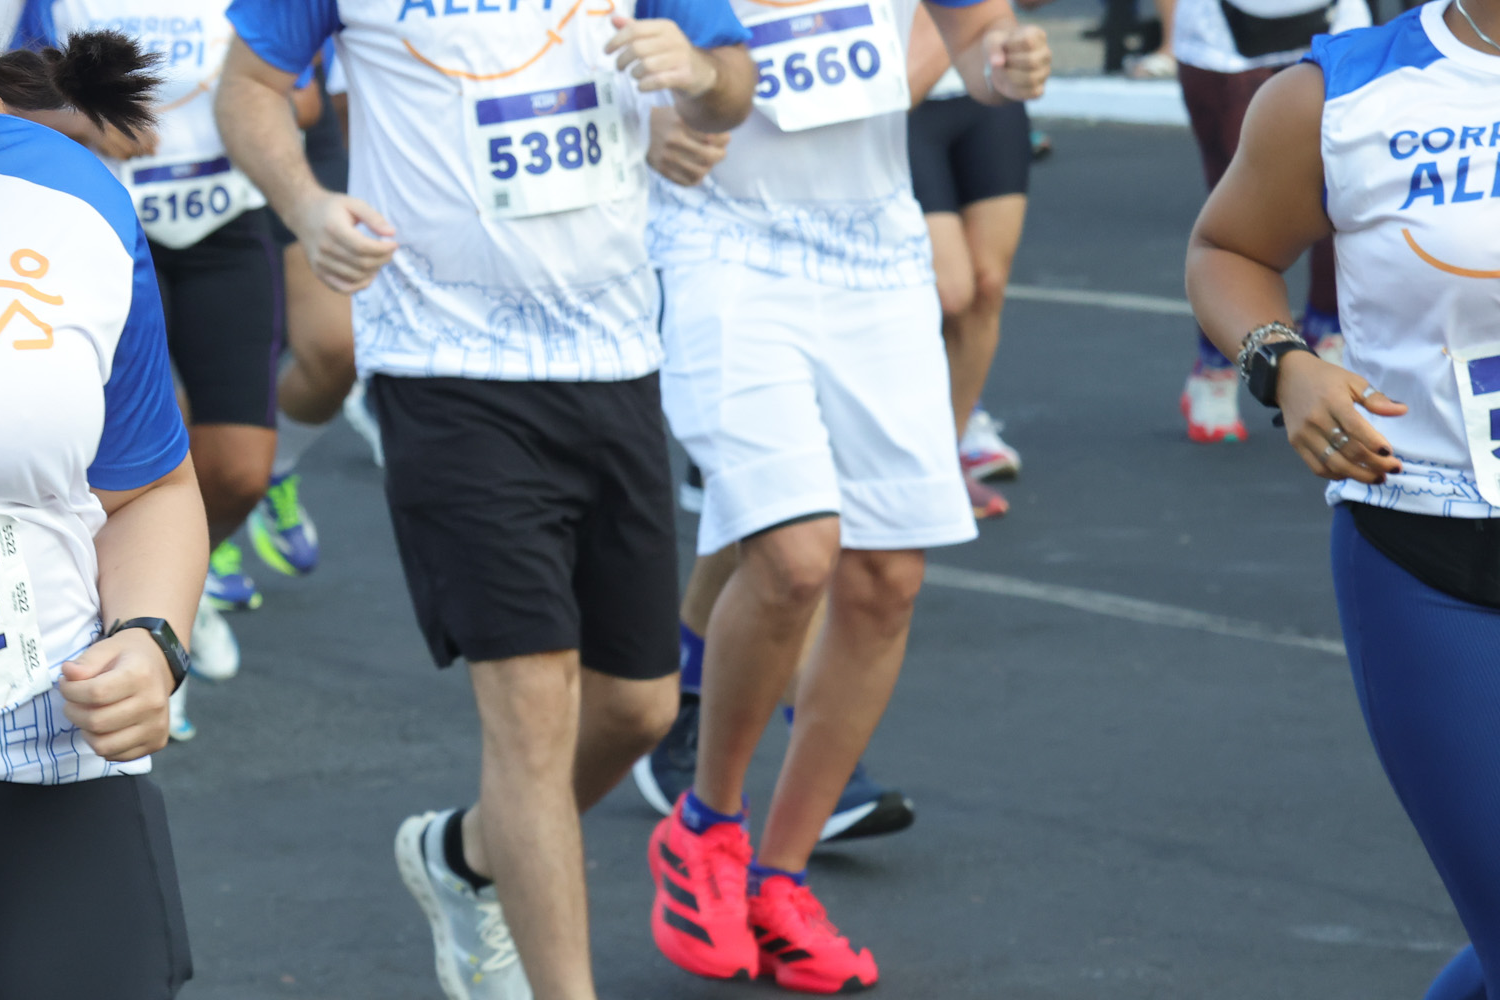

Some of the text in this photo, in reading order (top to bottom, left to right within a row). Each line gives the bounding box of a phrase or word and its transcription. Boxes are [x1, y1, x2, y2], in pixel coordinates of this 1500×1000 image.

[754, 40, 882, 100] 5660
[489, 121, 602, 181] 5388
[141, 184, 231, 223] 5160
[0, 523, 17, 556] 5522
[14, 581, 30, 614] 5522
[24, 637, 41, 671] 5522
